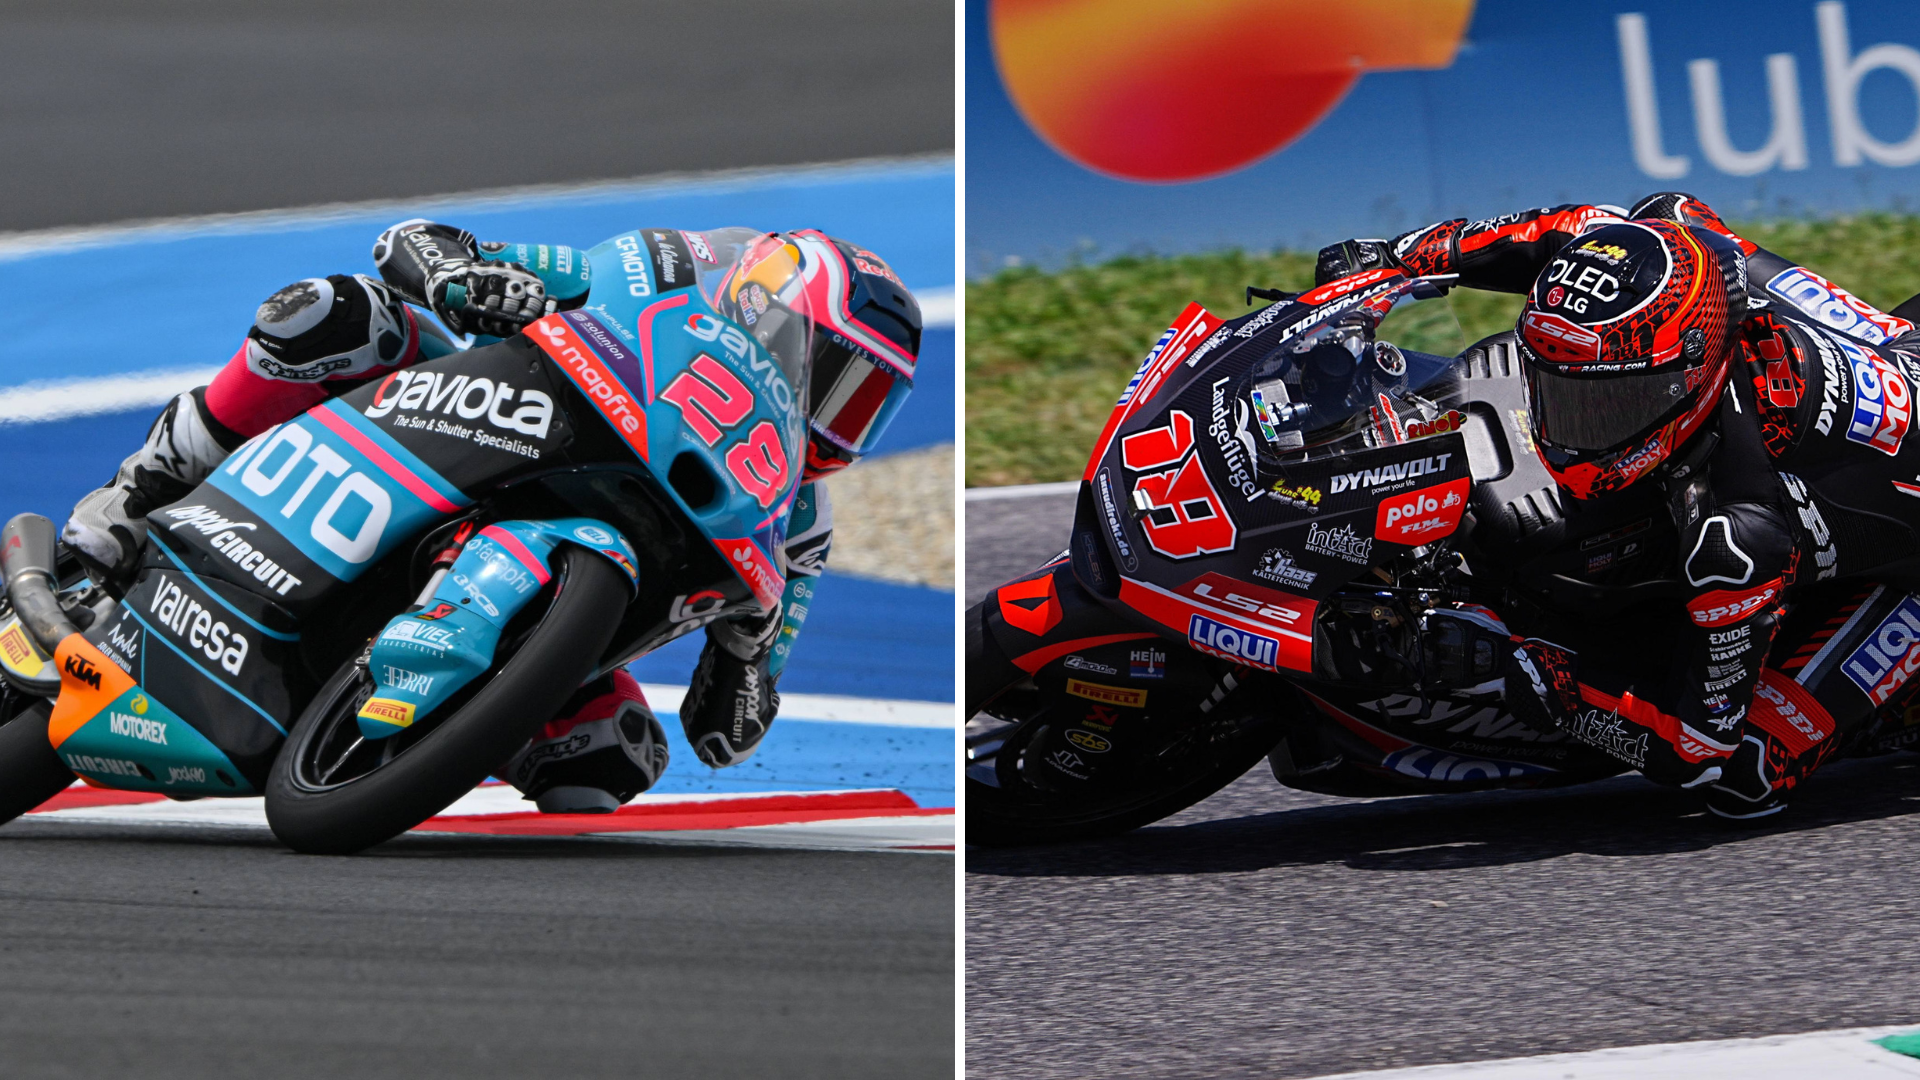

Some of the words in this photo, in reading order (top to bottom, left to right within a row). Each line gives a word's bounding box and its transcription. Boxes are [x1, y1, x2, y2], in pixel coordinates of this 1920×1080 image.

[615, 236, 651, 296] CFMOTO
[1333, 270, 1384, 294] polo
[1548, 258, 1620, 303] OLED
[1279, 281, 1390, 345] DYNAVOLT
[1563, 292, 1589, 314] LG
[1776, 272, 1885, 346] LIQUI
[585, 322, 625, 360] solunion
[1526, 315, 1599, 347] LS2
[724, 351, 740, 367] The
[739, 365, 755, 382] Sun
[833, 334, 868, 359] GIVES
[873, 357, 894, 373] YOU
[1758, 331, 1798, 408] 18
[364, 370, 554, 440] gaviota
[562, 346, 640, 434] mapfre
[1839, 373, 1849, 404] power
[393, 414, 409, 427] The
[409, 416, 426, 429] Sun
[426, 420, 434, 431] &
[435, 422, 473, 440] Shutter
[473, 430, 540, 460] Specialists
[656, 353, 789, 508] 28
[1208, 376, 1266, 503] Landgeflügel
[1617, 439, 1660, 469] LIQUI
[1622, 446, 1664, 478] MOLY
[1122, 409, 1237, 560] 18
[1330, 453, 1452, 494] DYNAVOLT
[1371, 485, 1391, 495] power
[1391, 482, 1404, 492] your
[1404, 479, 1416, 488] life
[1099, 473, 1129, 557] akkudirekt.de
[1386, 494, 1438, 528] polo
[1401, 517, 1441, 534] FLM
[583, 527, 606, 543] BELL
[210, 530, 302, 596] CIRCUIT
[478, 541, 536, 595] facephi
[1272, 558, 1318, 584] haas
[1305, 543, 1336, 559] BATTERY
[1342, 554, 1369, 566] POWER
[1252, 568, 1310, 590] KÄLTETECHNIK
[1193, 583, 1302, 625] LS2
[1694, 588, 1775, 622] SPIDI
[150, 574, 249, 677] valresa
[414, 623, 454, 647] VIEL
[1194, 618, 1274, 666] LIQUI
[1709, 625, 1751, 645] EXIDE
[1, 628, 31, 666] PIRELLI
[378, 639, 445, 659] CARROCERIAS
[1711, 642, 1752, 662] HANKE
[64, 653, 103, 691] KTM
[1704, 669, 1747, 692] PIRELLI
[1073, 683, 1140, 705] PIRELLI
[110, 711, 168, 745] MOTOREX
[365, 702, 408, 722] PIRELLI
[733, 697, 745, 743] CIRCUIT
[1070, 732, 1108, 751] sbs
[1044, 757, 1089, 780] ADVANTAGE
[1606, 748, 1646, 770] POWER
